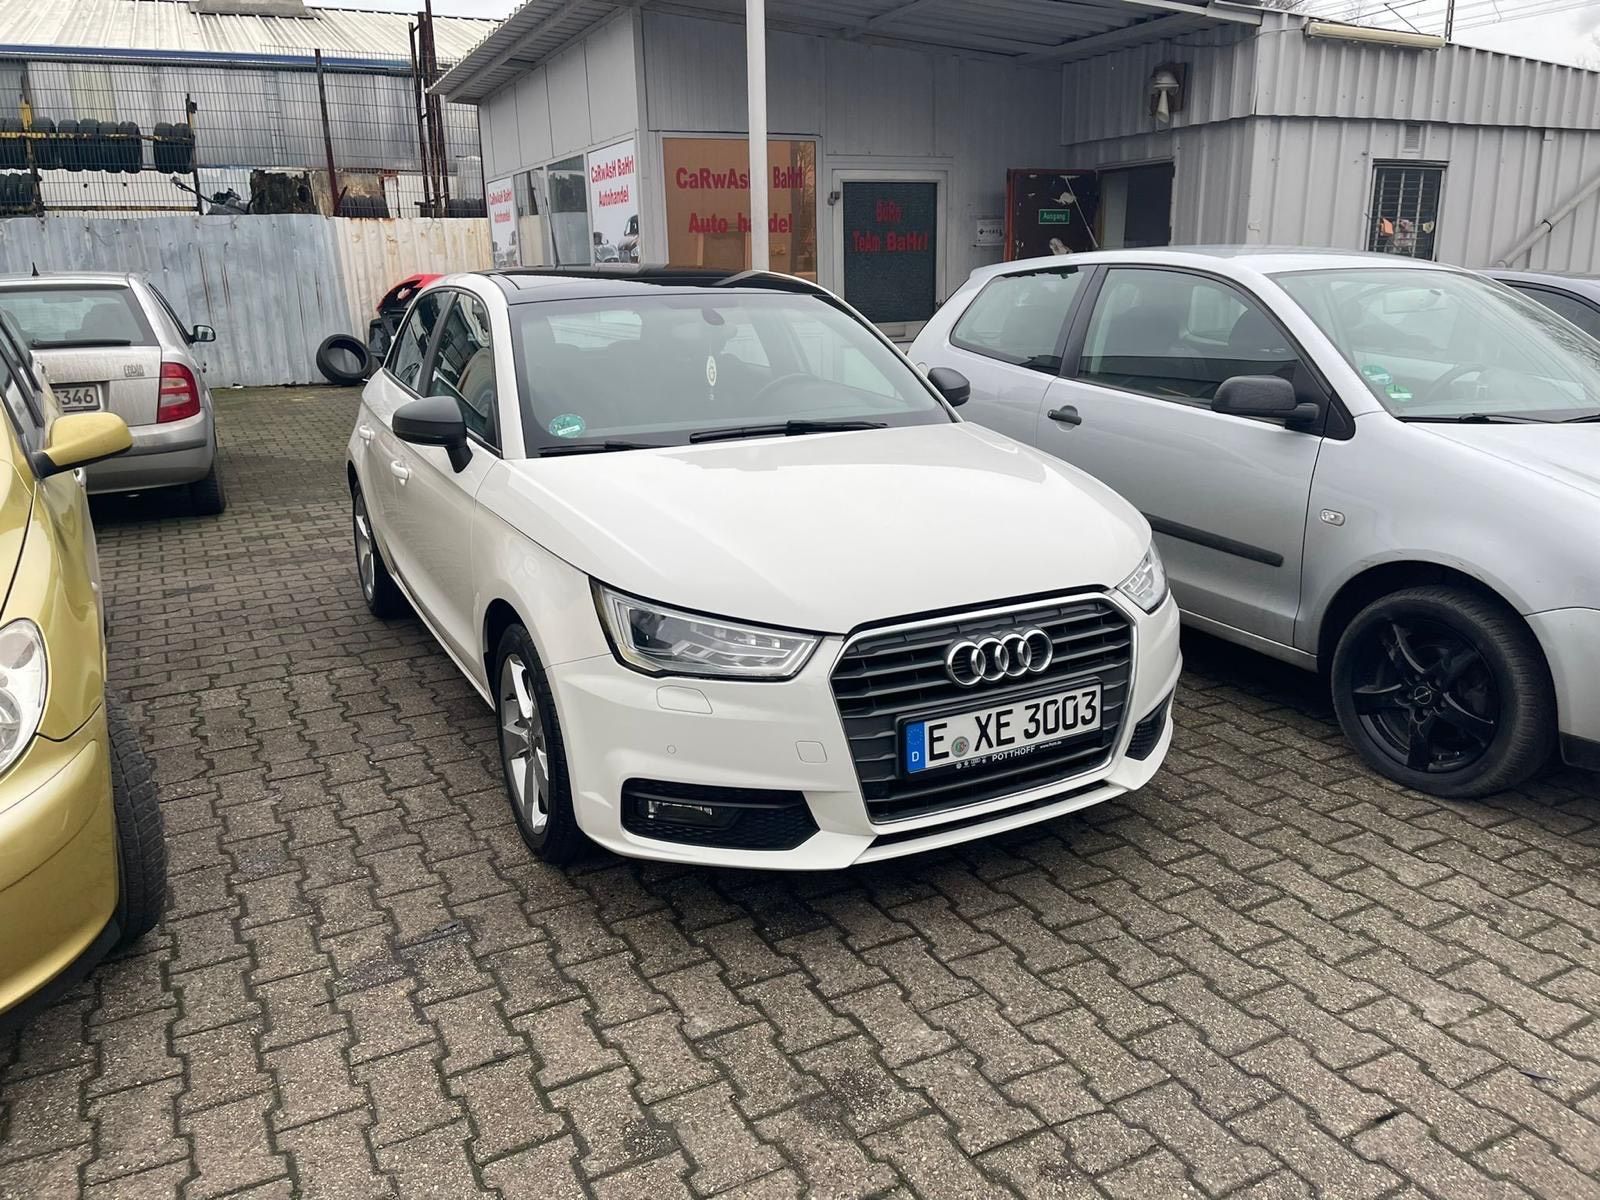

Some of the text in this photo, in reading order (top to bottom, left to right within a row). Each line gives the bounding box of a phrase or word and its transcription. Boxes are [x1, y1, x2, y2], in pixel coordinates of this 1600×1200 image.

[688, 212, 792, 233] Auto hdel
[1041, 211, 1066, 222] Ausgang
[928, 690, 1097, 762] E XE 3003
[911, 751, 920, 763] D
[991, 745, 1036, 762] POTTHOFF
